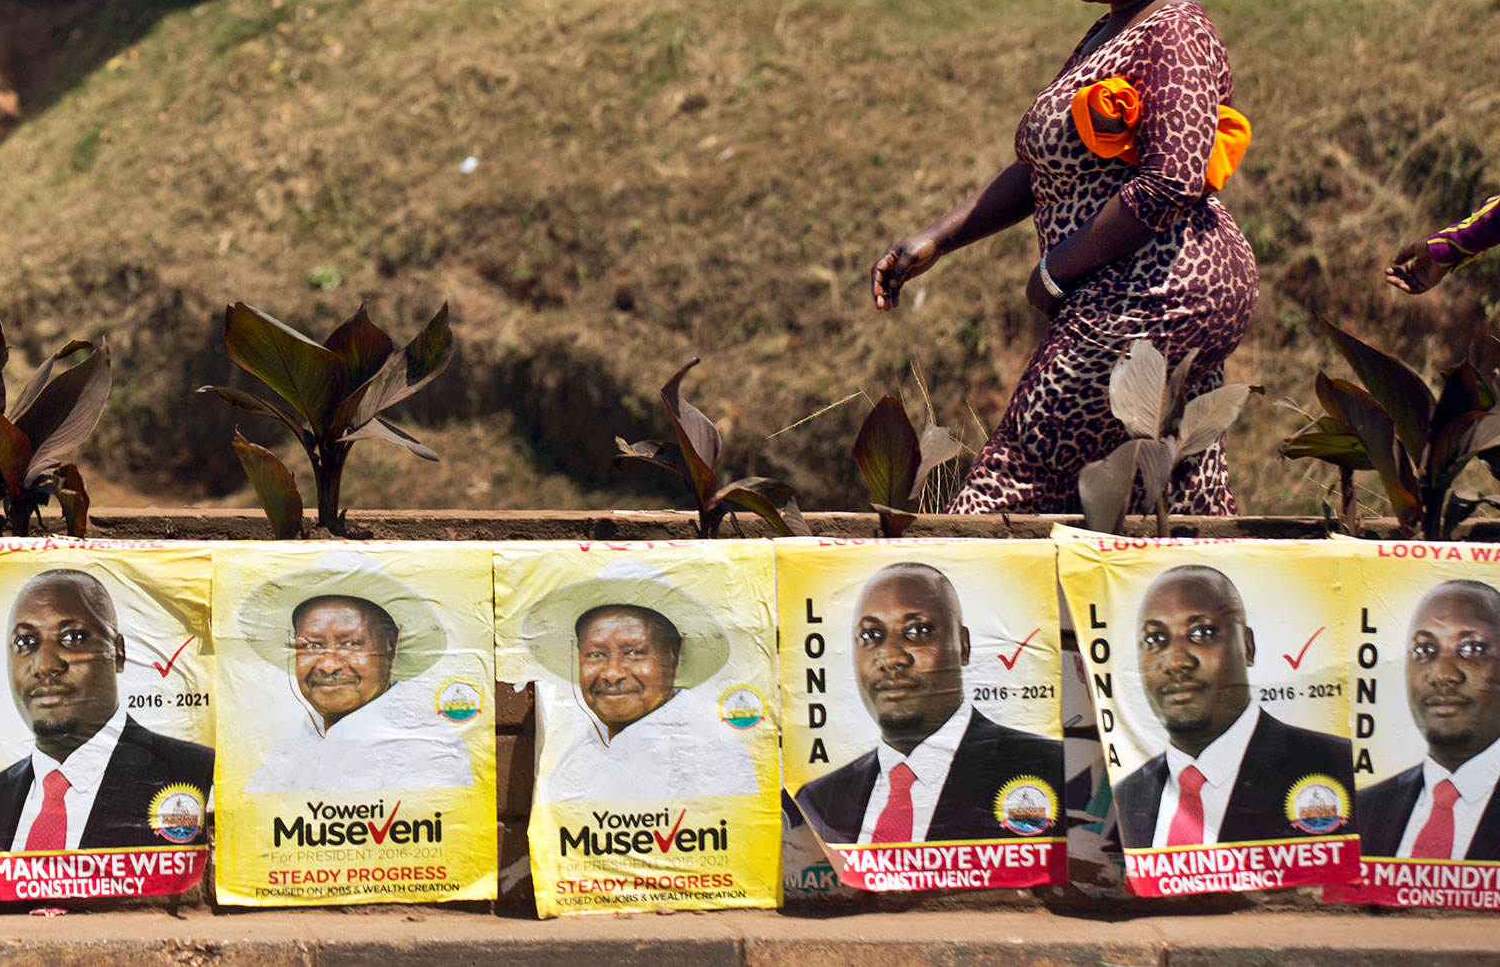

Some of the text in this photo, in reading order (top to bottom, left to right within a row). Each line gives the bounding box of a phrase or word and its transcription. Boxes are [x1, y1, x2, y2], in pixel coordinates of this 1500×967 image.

[1377, 544, 1462, 560] LOOYA
[805, 598, 829, 763] LONDA
[1089, 603, 1121, 767] LONDA
[1354, 608, 1378, 774] LONDA
[128, 694, 163, 708] 2016
[176, 693, 210, 707] 2021
[973, 686, 1008, 701] 2016
[1021, 685, 1055, 699] 2021
[1260, 687, 1295, 701] 2016
[1308, 683, 1342, 698] 2021
[307, 799, 384, 820] Yoweri
[592, 807, 669, 829] Yoweri
[273, 800, 442, 847] Museveni
[559, 808, 728, 856] Museveni
[129, 852, 198, 876] WEST
[271, 847, 442, 863] For PRESIDENT 2016-2021
[841, 844, 1052, 872] MAKINDYE WEST
[1137, 847, 1268, 878] MAKINDYE
[1269, 842, 1344, 868] WEST
[268, 866, 447, 885] STEADY PROGRESS
[556, 874, 734, 894] STEADY PROGRESS
[864, 870, 992, 891] CONSTITUENCY
[1159, 869, 1285, 895] CONSTITUENCY
[16, 877, 145, 898] CONSTITUENCY
[256, 883, 460, 897] FOCUSED ON JOBS & WEALTH CREATION
[594, 894, 611, 904] ON
[612, 893, 639, 903] JOBS
[641, 893, 648, 902] &
[649, 892, 694, 901] WEALTH
[694, 890, 747, 900] CREATION
